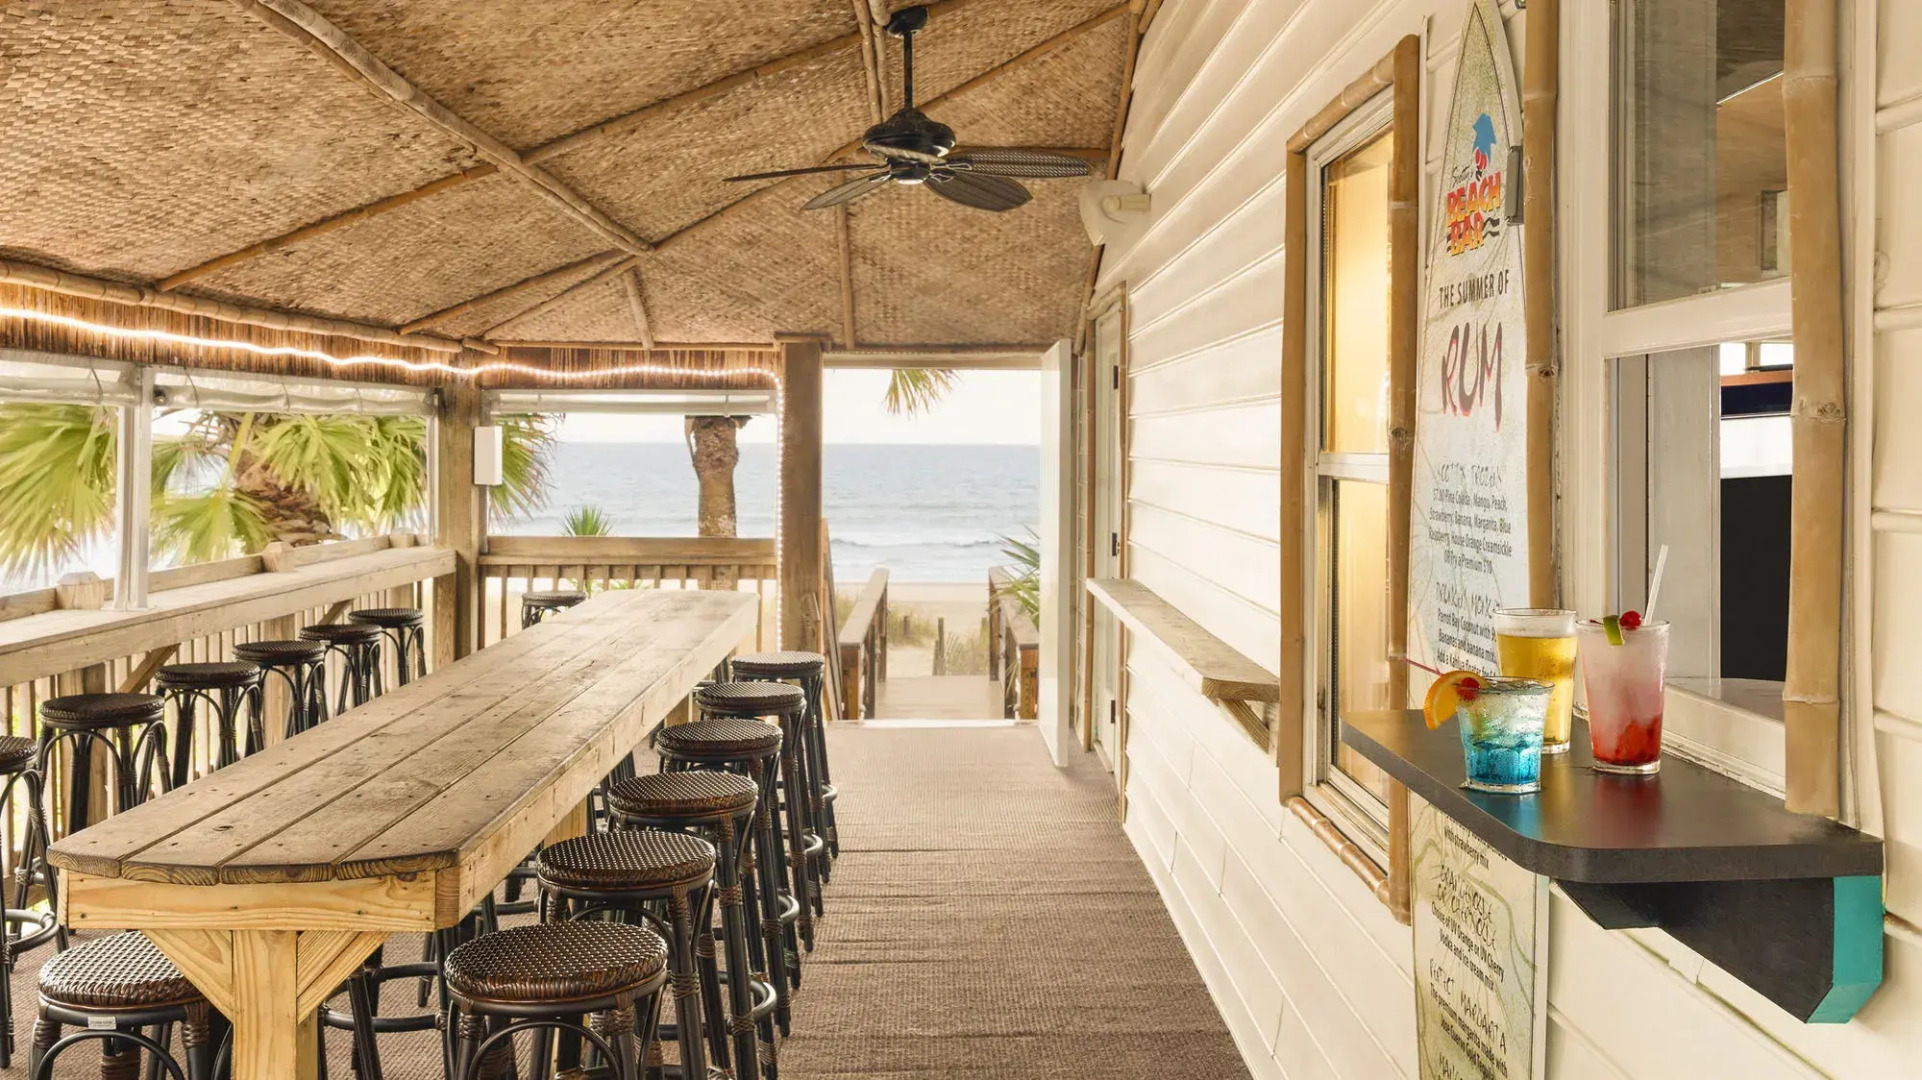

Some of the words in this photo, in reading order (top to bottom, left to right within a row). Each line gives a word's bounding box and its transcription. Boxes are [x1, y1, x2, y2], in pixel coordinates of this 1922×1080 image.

[1447, 172, 1501, 225] BEACH
[1450, 211, 1484, 257] BAR
[1439, 284, 1455, 310] THE
[1457, 273, 1495, 305] SUMMER
[1498, 269, 1510, 295] OF
[1441, 324, 1503, 433] RUM
[1499, 517, 1511, 535] Blue
[1437, 608, 1451, 626] Parrot
[1451, 612, 1460, 632] Bay
[1460, 616, 1479, 636] Coconut
[1479, 622, 1491, 640] with
[1438, 628, 1457, 648] Bananas
[1457, 634, 1466, 651] and
[1432, 901, 1445, 925] Choice
[1457, 924, 1474, 953] Orange
[1479, 944, 1487, 963] UV
[1487, 952, 1505, 983] Cherry
[1453, 943, 1462, 961] and
[1469, 960, 1484, 982] cream
[1484, 974, 1494, 991] mix
[1430, 982, 1438, 1002] The
[1438, 994, 1457, 1023] premium
[1457, 1014, 1481, 1049] margarita
[1481, 1040, 1495, 1065] made
[1495, 1057, 1508, 1079] with
[1460, 989, 1507, 1055] MARGARITA
